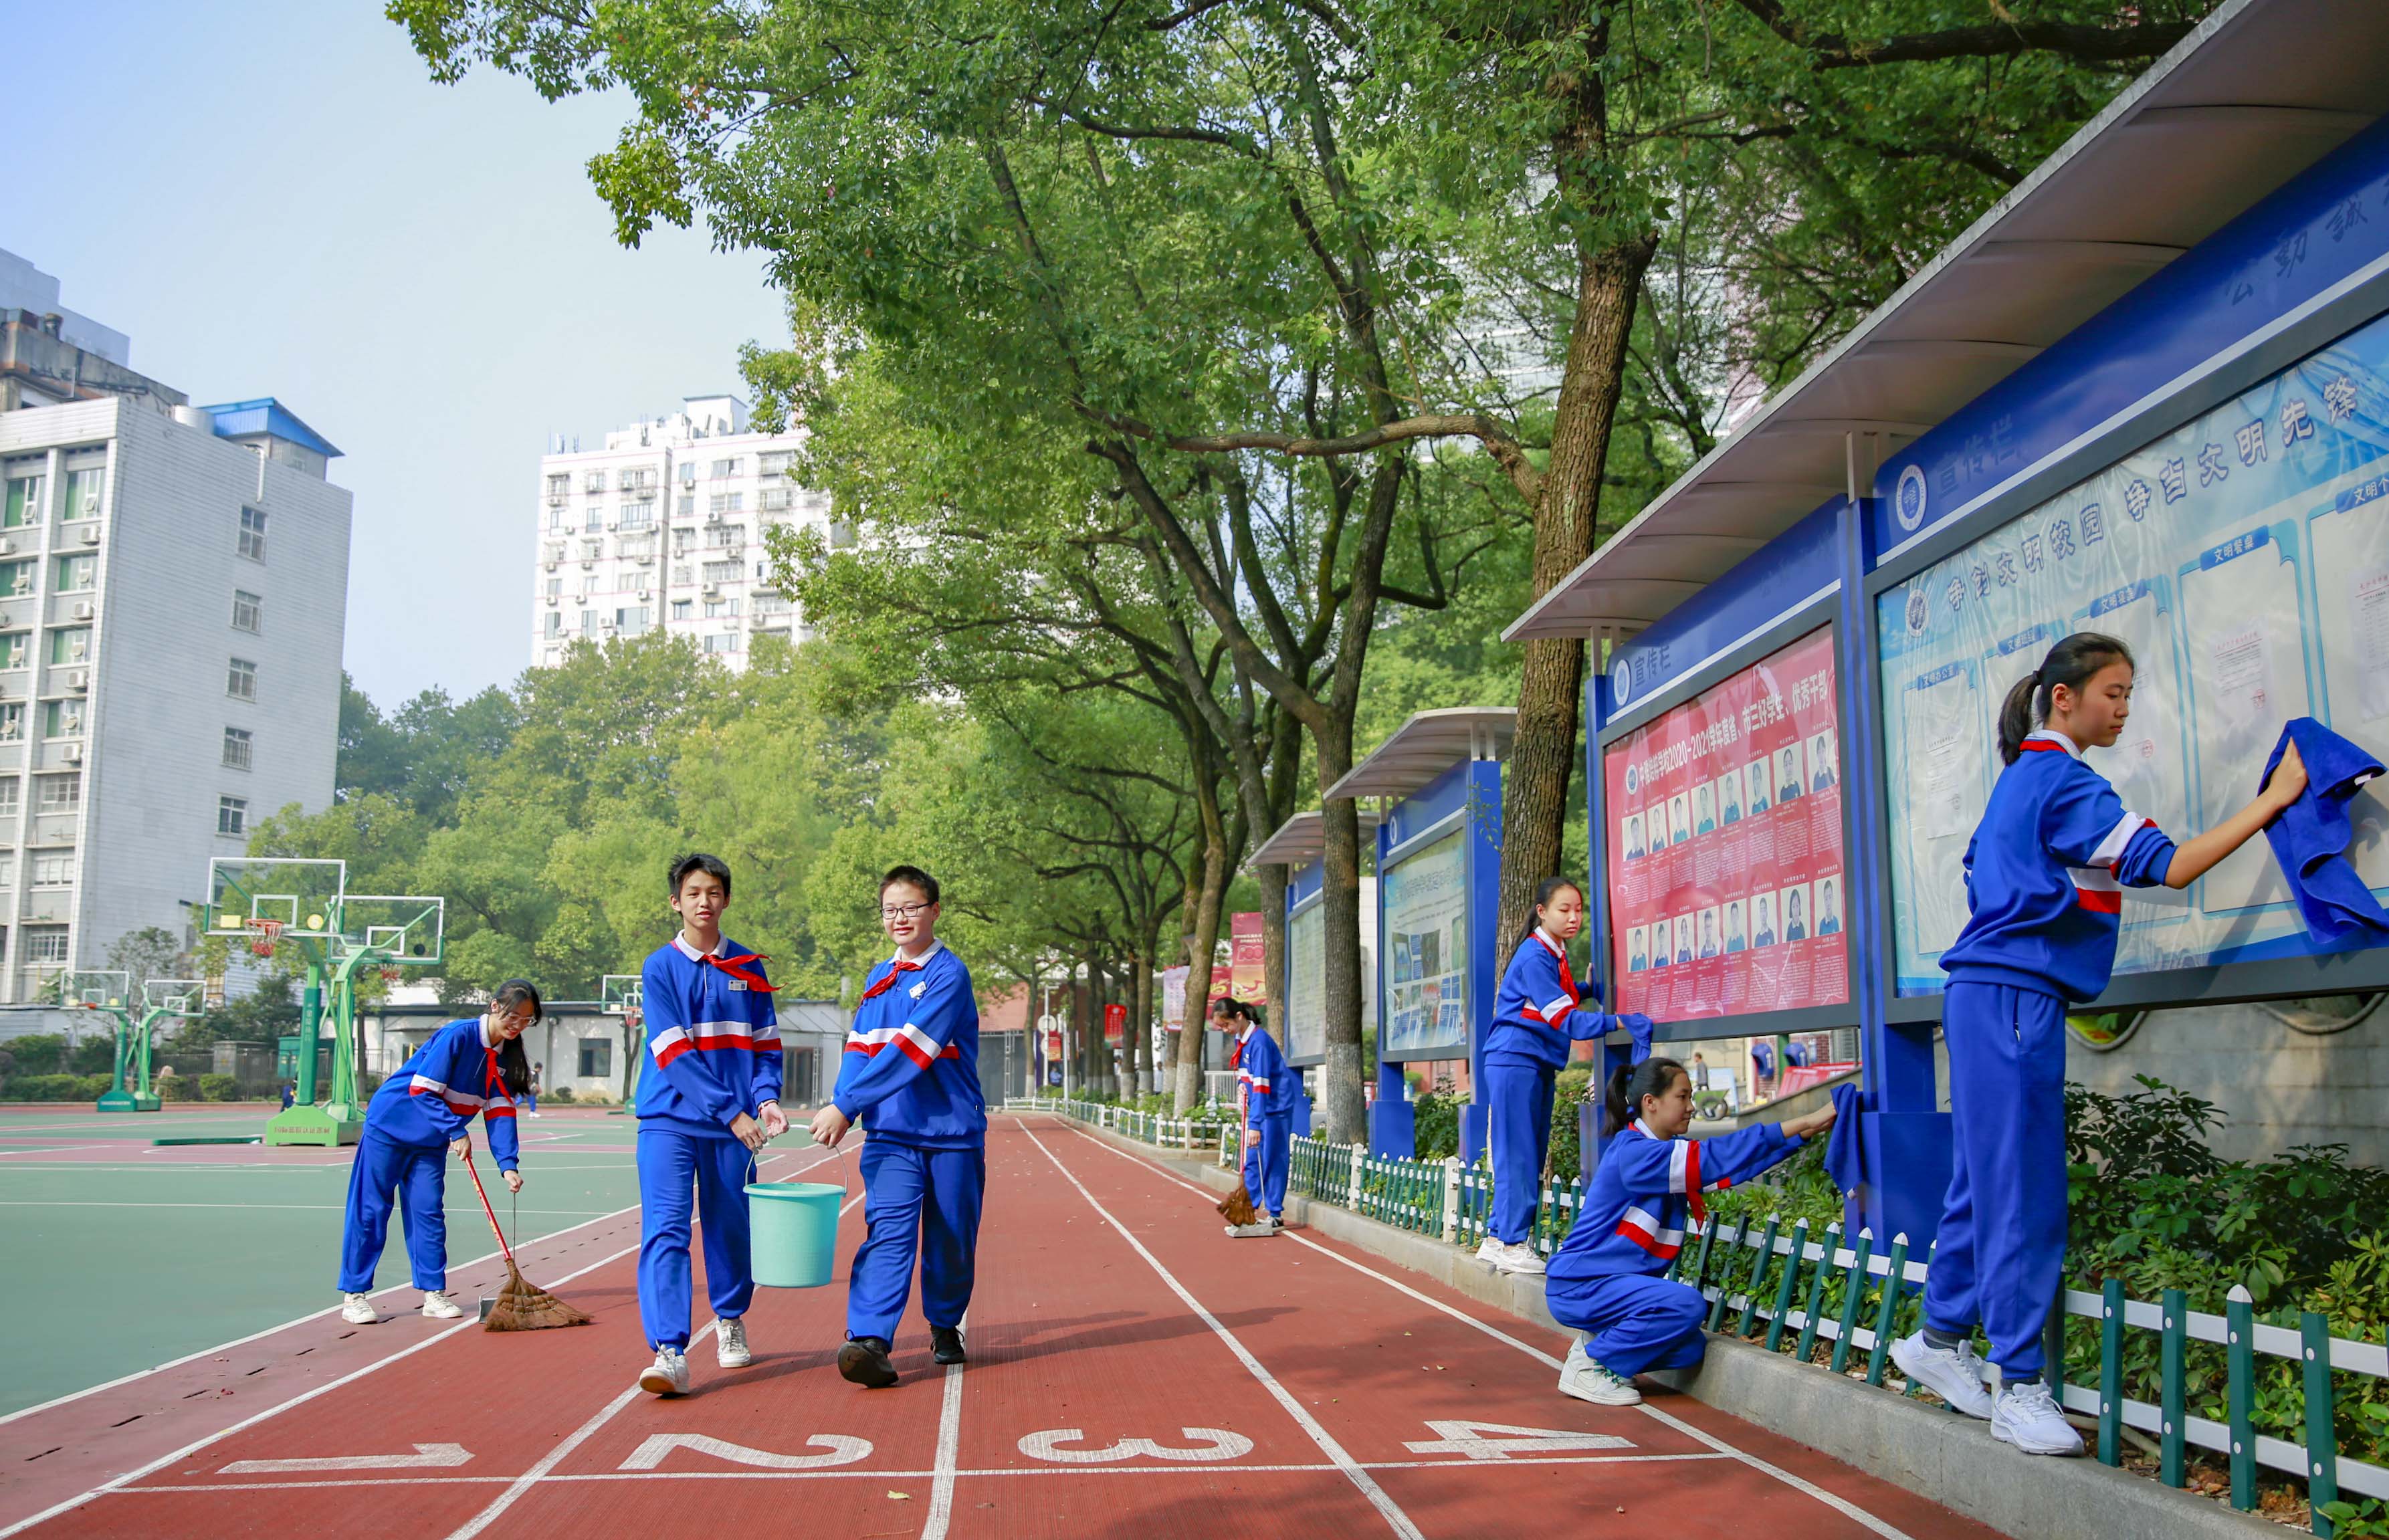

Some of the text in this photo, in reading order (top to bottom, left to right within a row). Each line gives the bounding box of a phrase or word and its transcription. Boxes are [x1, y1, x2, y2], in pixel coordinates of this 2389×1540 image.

[1947, 374, 2358, 611] 争创文明校园 争当文明先锋
[2213, 534, 2255, 563] 文明餐桌
[217, 1442, 474, 1474] 1
[616, 1433, 873, 1470] 2
[1017, 1426, 1254, 1462] 3
[1401, 1420, 1638, 1460] 4
